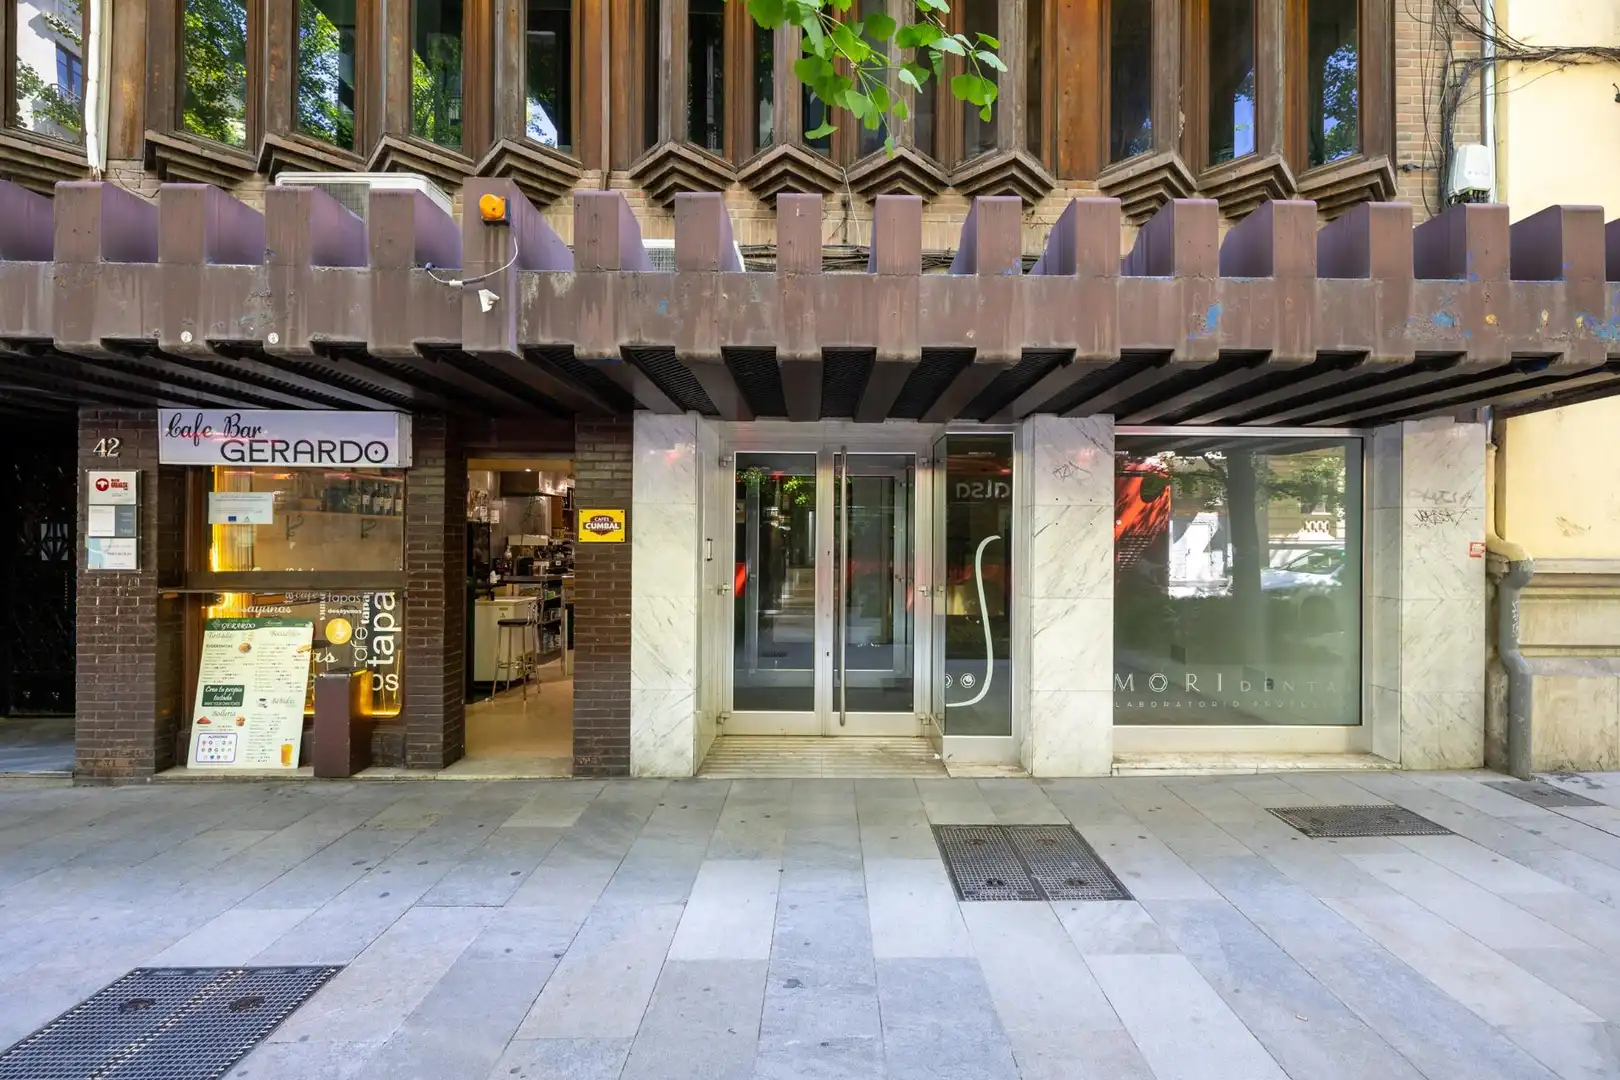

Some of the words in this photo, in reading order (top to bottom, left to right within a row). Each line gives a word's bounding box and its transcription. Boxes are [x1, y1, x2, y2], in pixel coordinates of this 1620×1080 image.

[166, 412, 212, 446] Cafe
[223, 413, 262, 438] Bar
[93, 437, 121, 458] 42
[220, 439, 389, 463] GERARDO
[585, 522, 620, 530] CUMBAL
[1113, 672, 1223, 693] MORI
